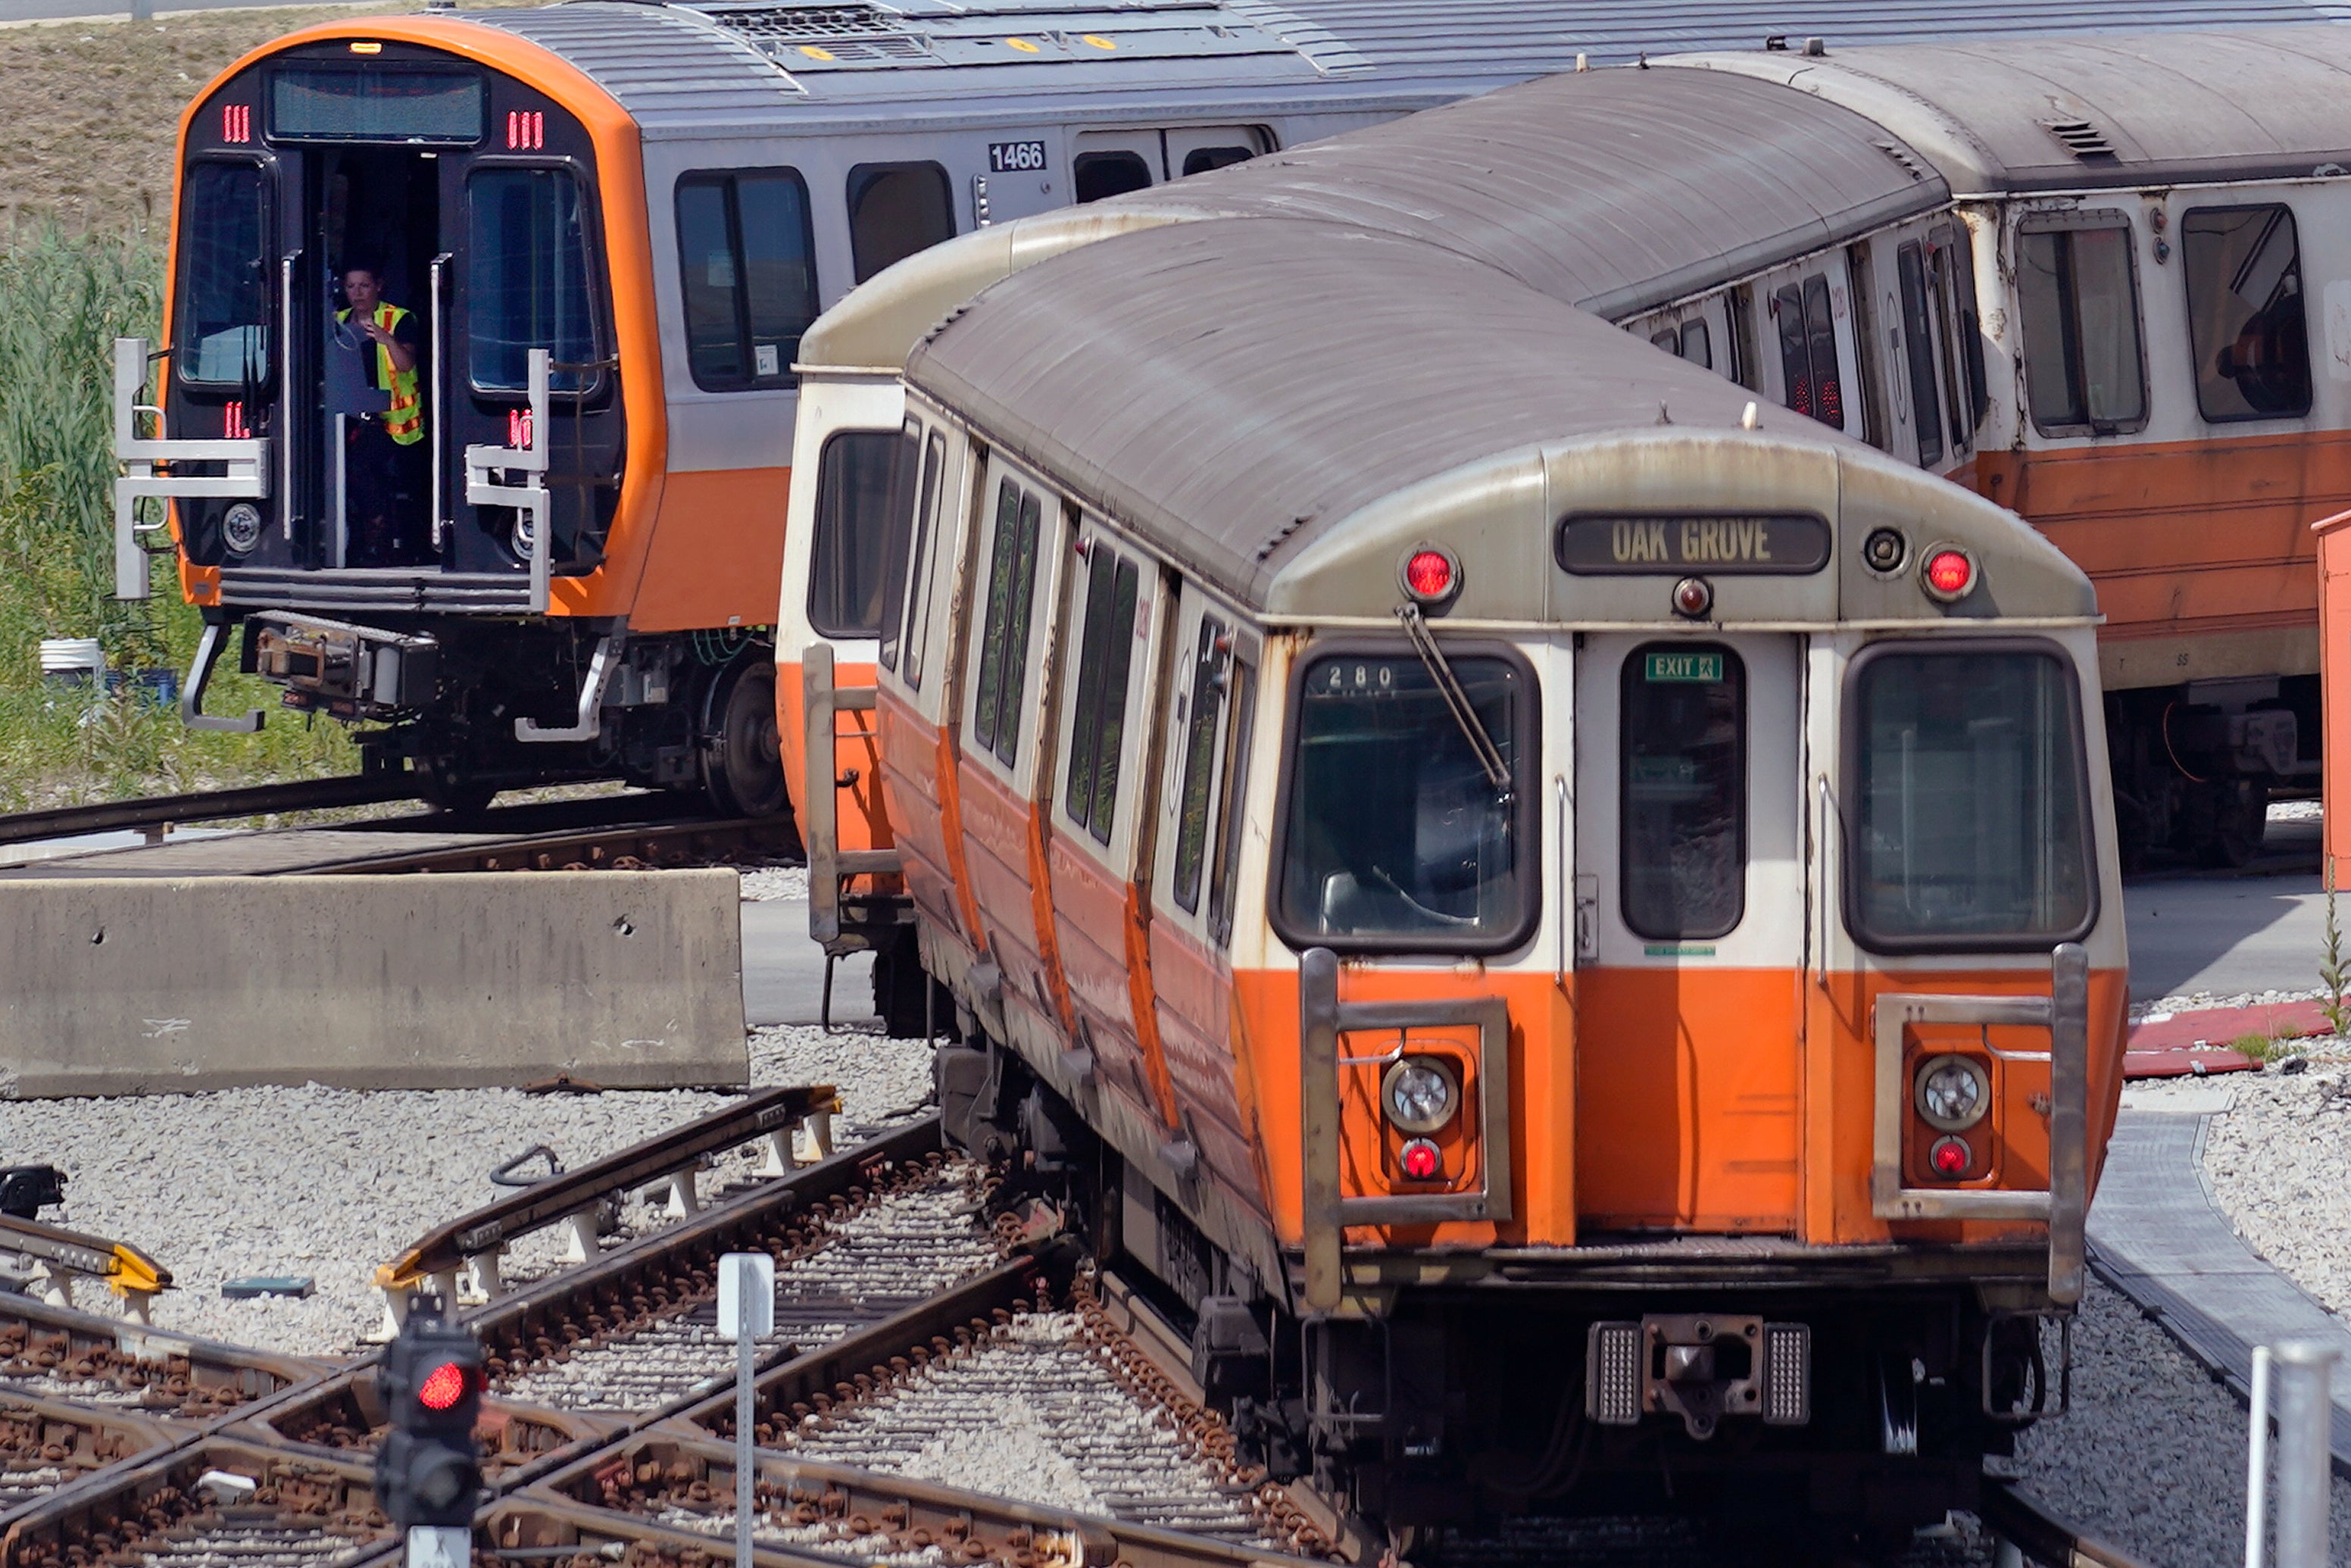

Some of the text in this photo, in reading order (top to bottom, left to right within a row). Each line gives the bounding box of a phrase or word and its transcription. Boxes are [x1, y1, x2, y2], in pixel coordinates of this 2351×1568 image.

[991, 142, 1043, 170] 1466
[1613, 517, 1772, 563] OAK GROVE
[1656, 657, 1693, 676] EXIT
